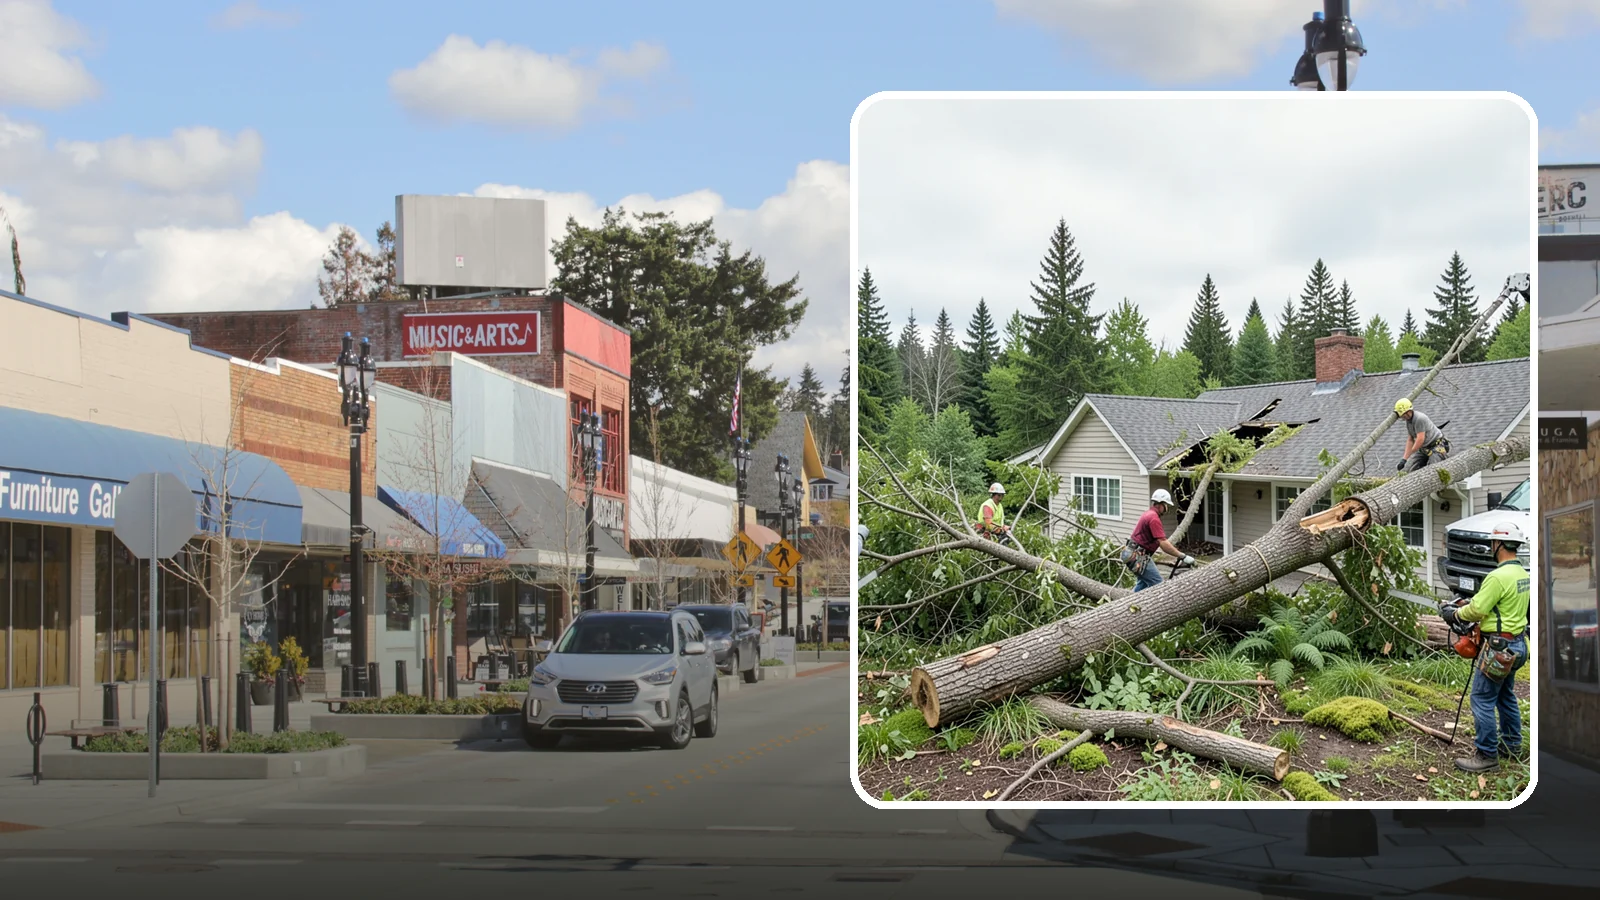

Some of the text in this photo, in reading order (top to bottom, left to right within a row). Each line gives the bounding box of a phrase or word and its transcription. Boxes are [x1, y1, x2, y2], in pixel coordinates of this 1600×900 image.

[409, 323, 519, 349] MUSIC&ARTS
[90, 482, 122, 519] Gal
[454, 563, 479, 575] SUSHI
